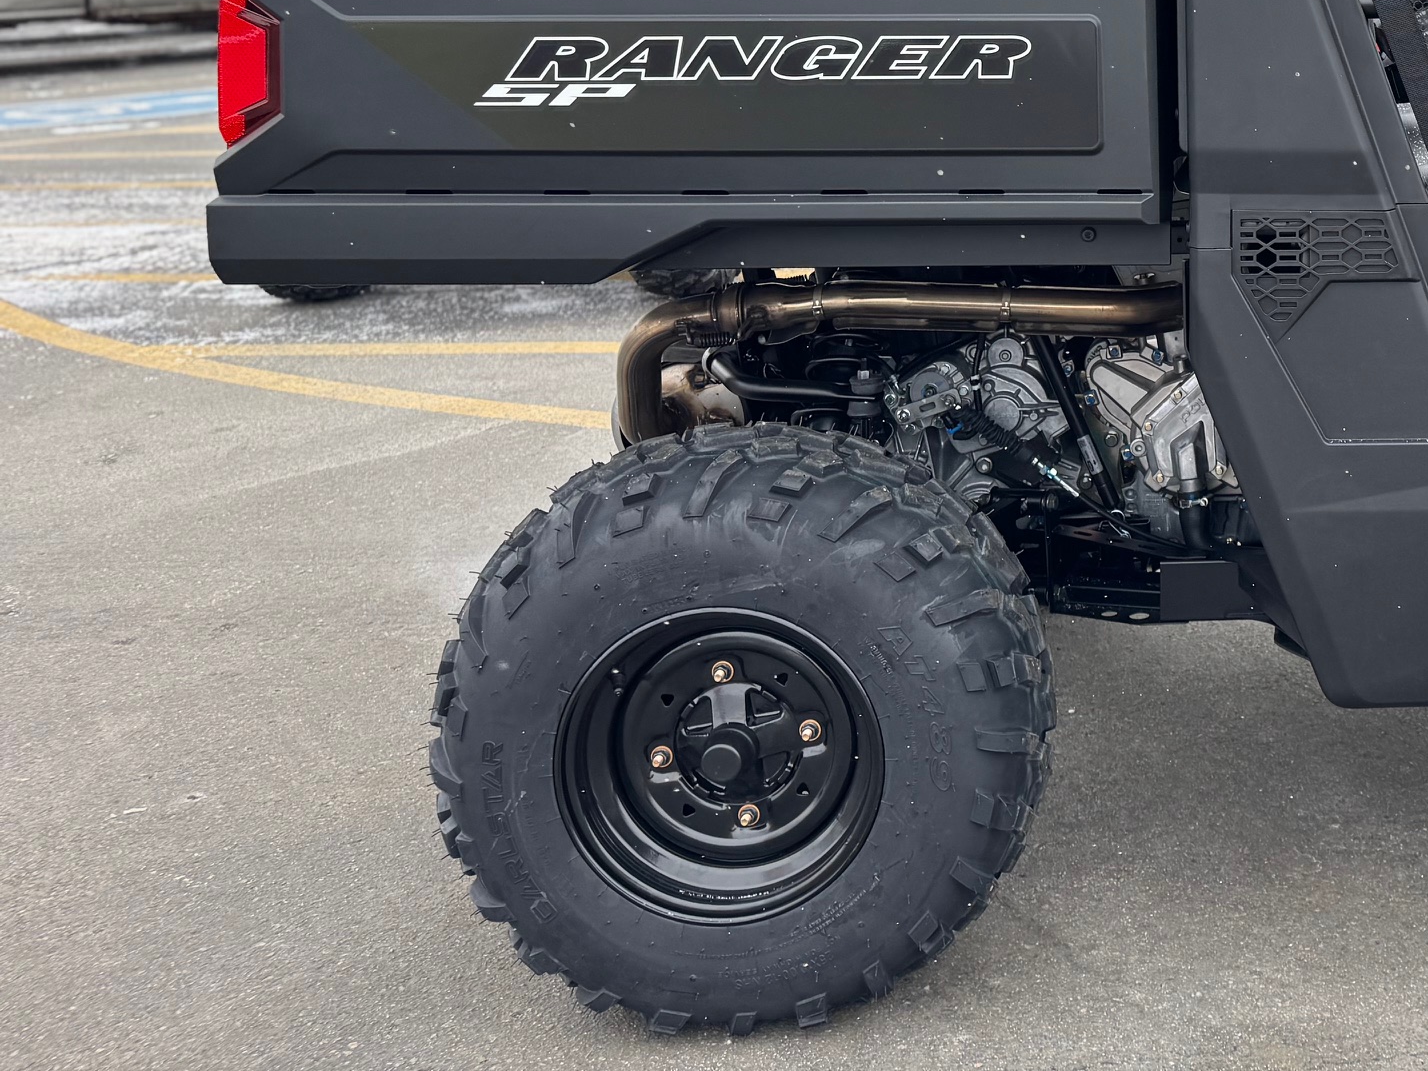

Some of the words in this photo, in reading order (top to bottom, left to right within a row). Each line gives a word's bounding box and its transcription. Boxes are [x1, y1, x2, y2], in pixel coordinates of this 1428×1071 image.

[505, 35, 1032, 81] RANGER
[473, 83, 636, 106] SP
[876, 625, 953, 792] AT489
